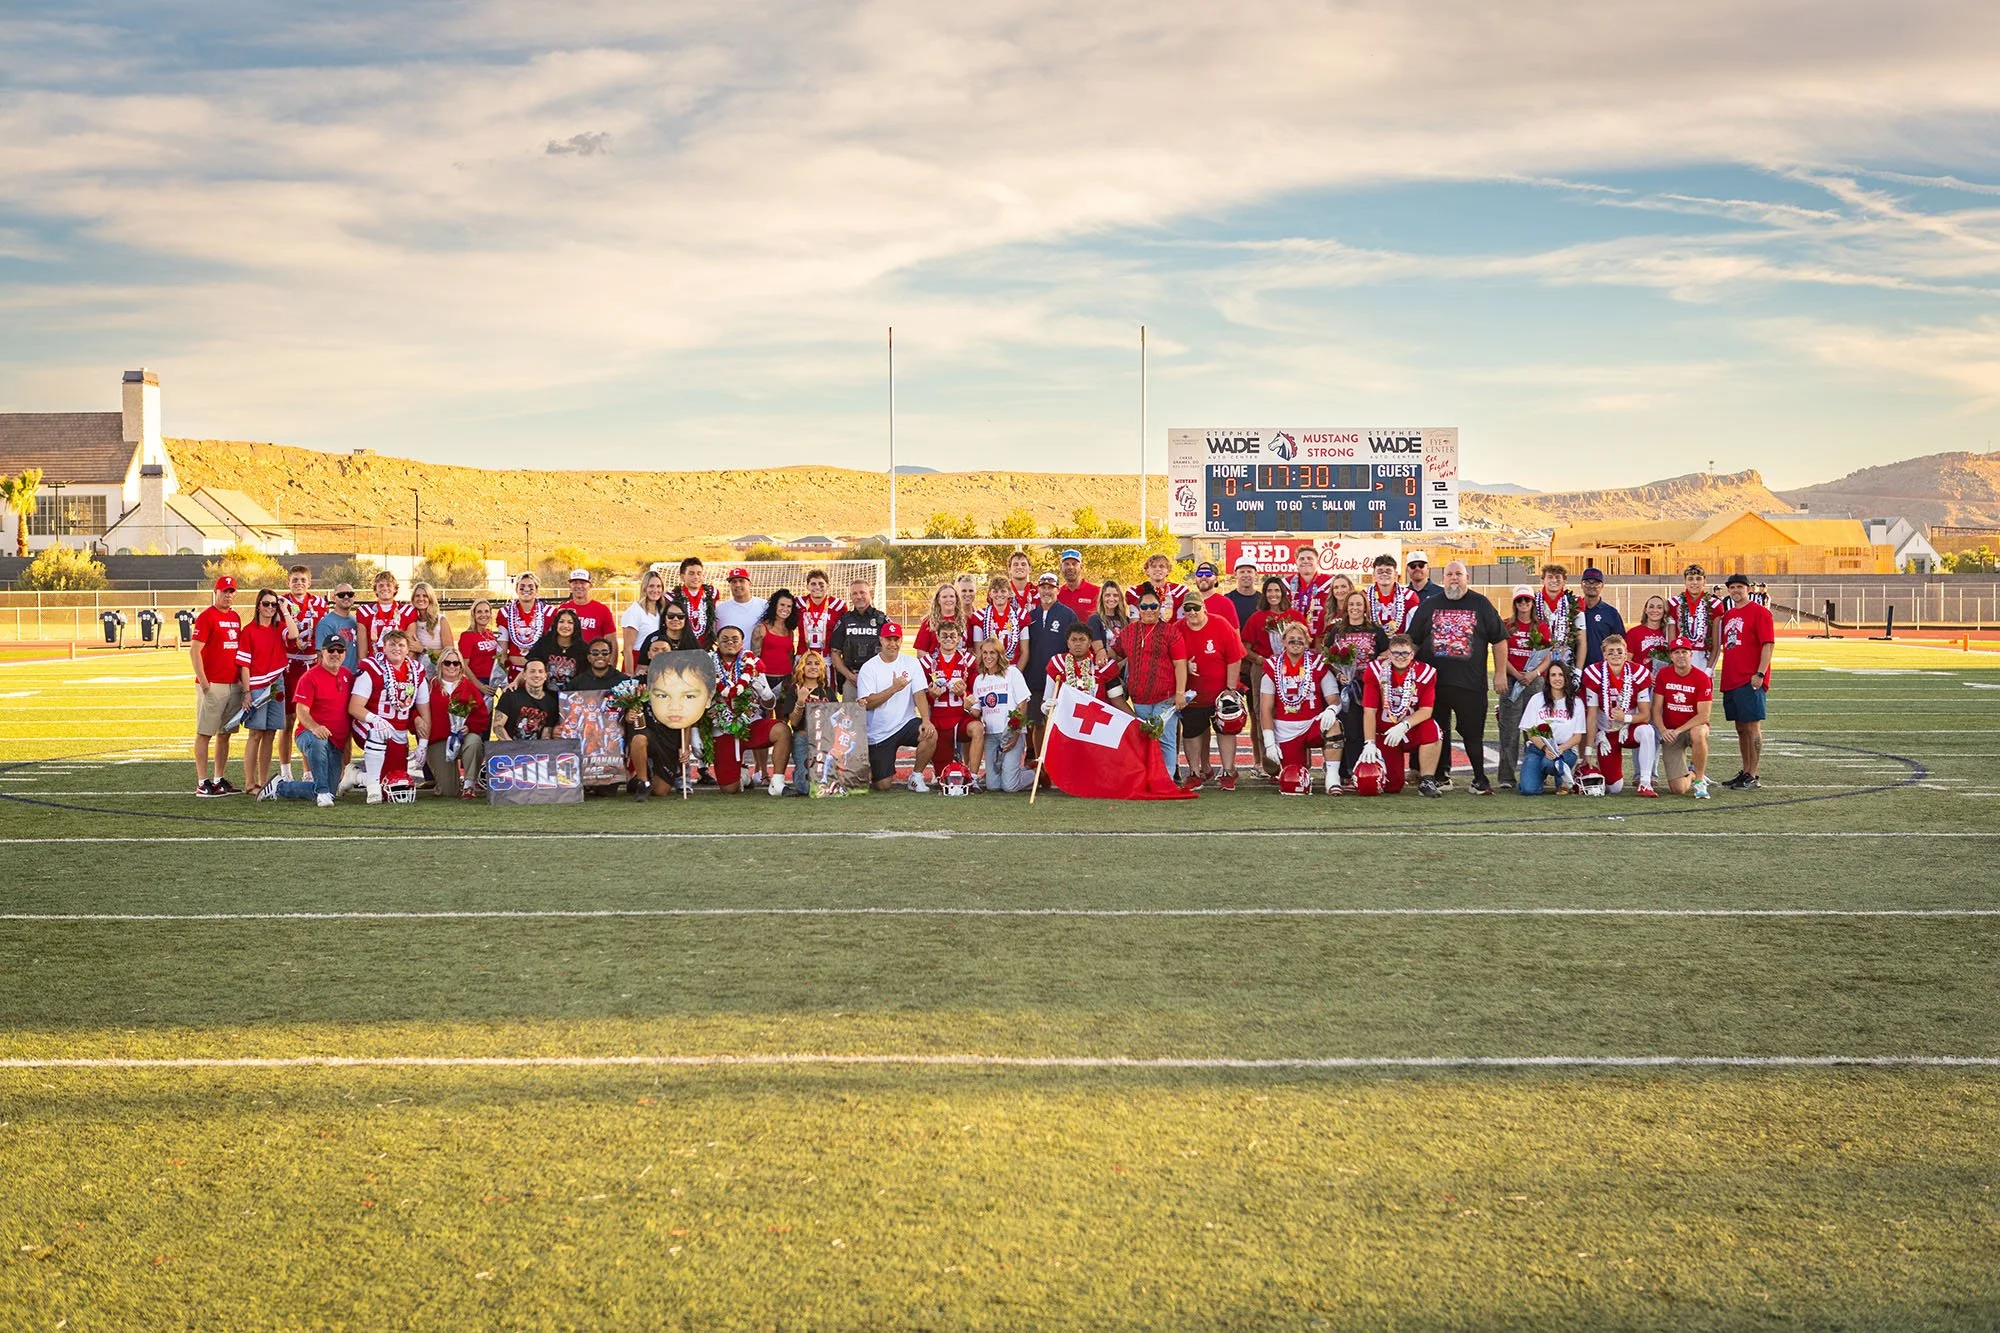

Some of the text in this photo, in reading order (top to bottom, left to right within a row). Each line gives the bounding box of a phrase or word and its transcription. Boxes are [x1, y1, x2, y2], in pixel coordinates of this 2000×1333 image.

[1302, 433, 1359, 443] MUSTANG
[1206, 437, 1260, 454] WADE
[1368, 437, 1421, 453] WADE
[1307, 448, 1354, 457] STRONG
[1425, 454, 1438, 464] See
[1213, 465, 1248, 478] HOME
[1377, 464, 1417, 478] GUEST
[1429, 460, 1449, 472] Fight
[1267, 465, 1329, 488] 17:30
[1225, 477, 1237, 497] 0
[1405, 477, 1417, 496] 0
[1212, 503, 1220, 517] 3
[1236, 500, 1264, 511] DOWN
[1275, 500, 1303, 511] TO GO
[1322, 500, 1356, 511] BALL ON
[1368, 500, 1386, 511] QTR
[1408, 502, 1417, 517] 3
[1207, 521, 1230, 532] T.O.L.
[1399, 521, 1421, 531] T.O.L.
[1241, 545, 1290, 563] RED
[1319, 548, 1375, 573] Chick-fi
[1256, 563, 1299, 572] NGDOM
[846, 627, 878, 636] POLICE
[1539, 709, 1573, 721] CRMSON
[814, 709, 823, 773] SENIOR
[838, 733, 850, 748] 42
[488, 753, 581, 792] SOLO
